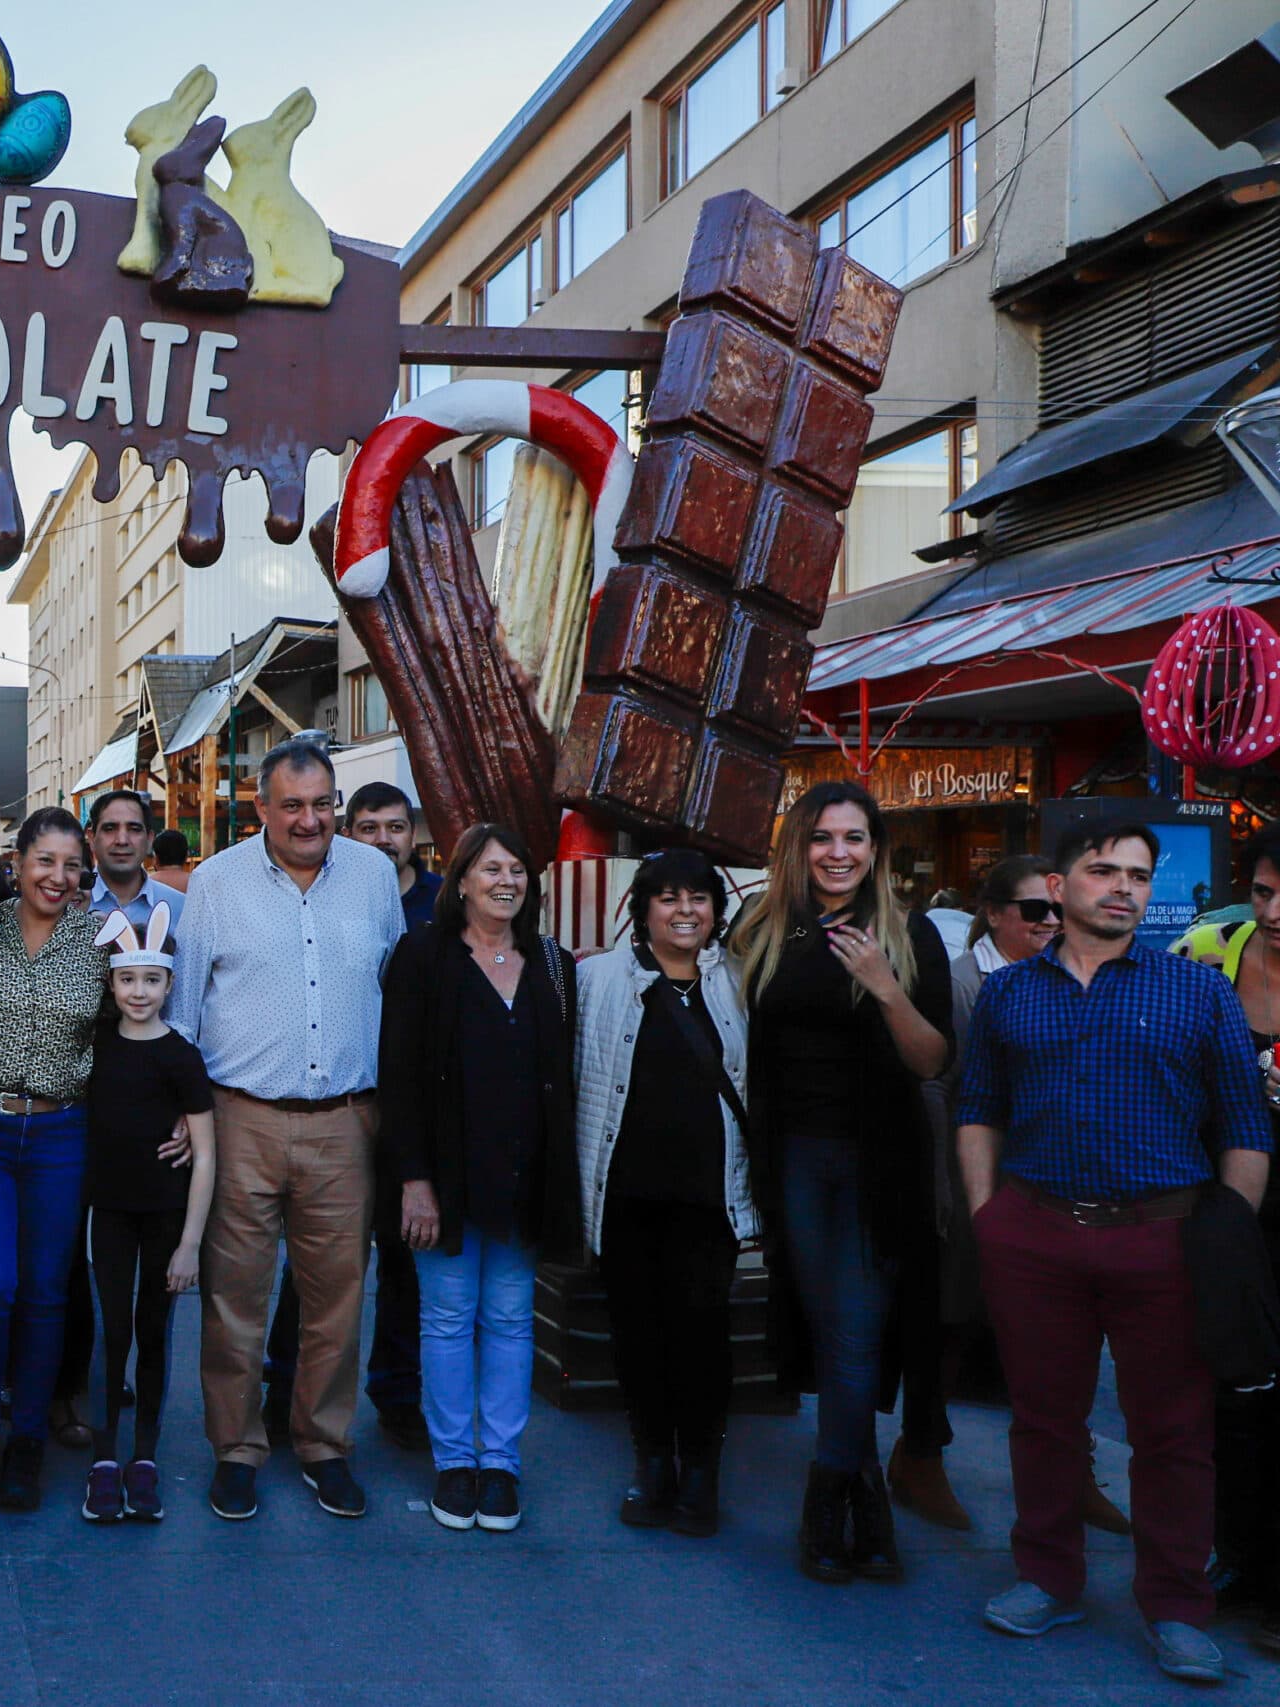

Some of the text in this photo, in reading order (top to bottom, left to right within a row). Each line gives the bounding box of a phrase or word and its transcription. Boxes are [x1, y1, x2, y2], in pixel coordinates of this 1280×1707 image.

[910, 763, 1009, 800] El Bosque
[1158, 905, 1166, 914] DE
[1167, 905, 1176, 914] LA
[1176, 905, 1197, 914] MAGIA
[1145, 915, 1171, 924] NAHUEL
